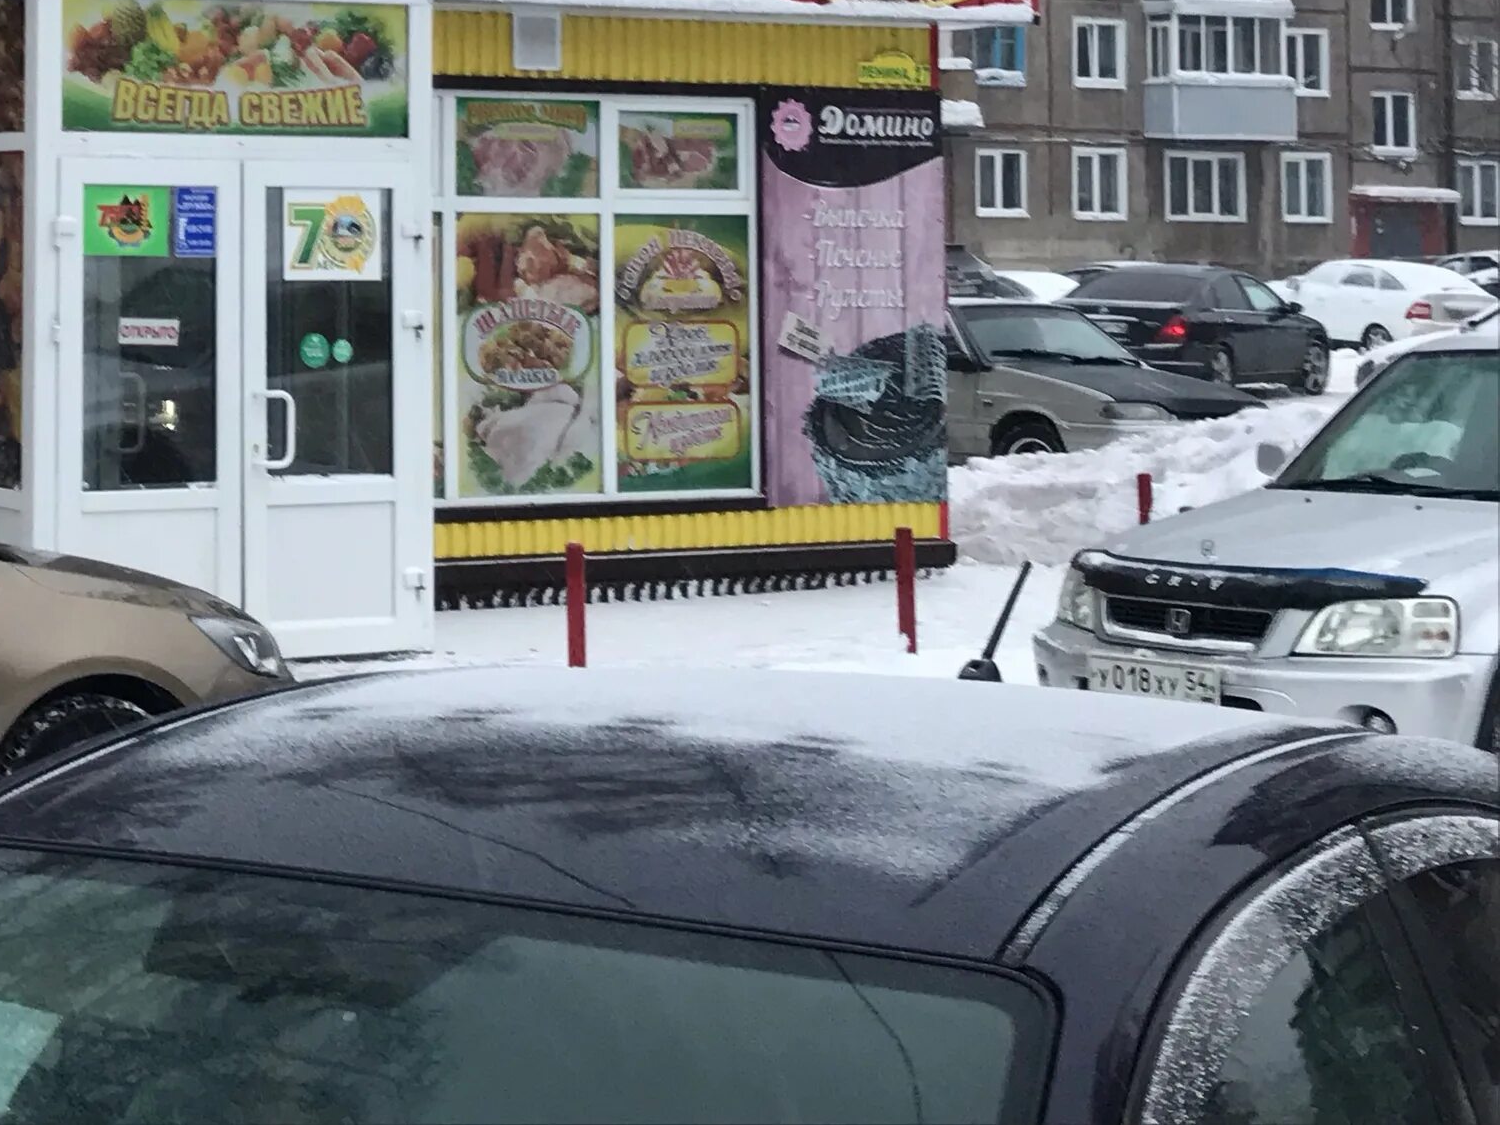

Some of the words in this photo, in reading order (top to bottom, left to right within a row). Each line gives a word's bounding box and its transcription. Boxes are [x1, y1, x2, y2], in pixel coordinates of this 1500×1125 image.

[112, 78, 230, 129] ВСЕГДА
[239, 84, 367, 127] СВЕЖИЕ
[817, 105, 935, 139] Домино
